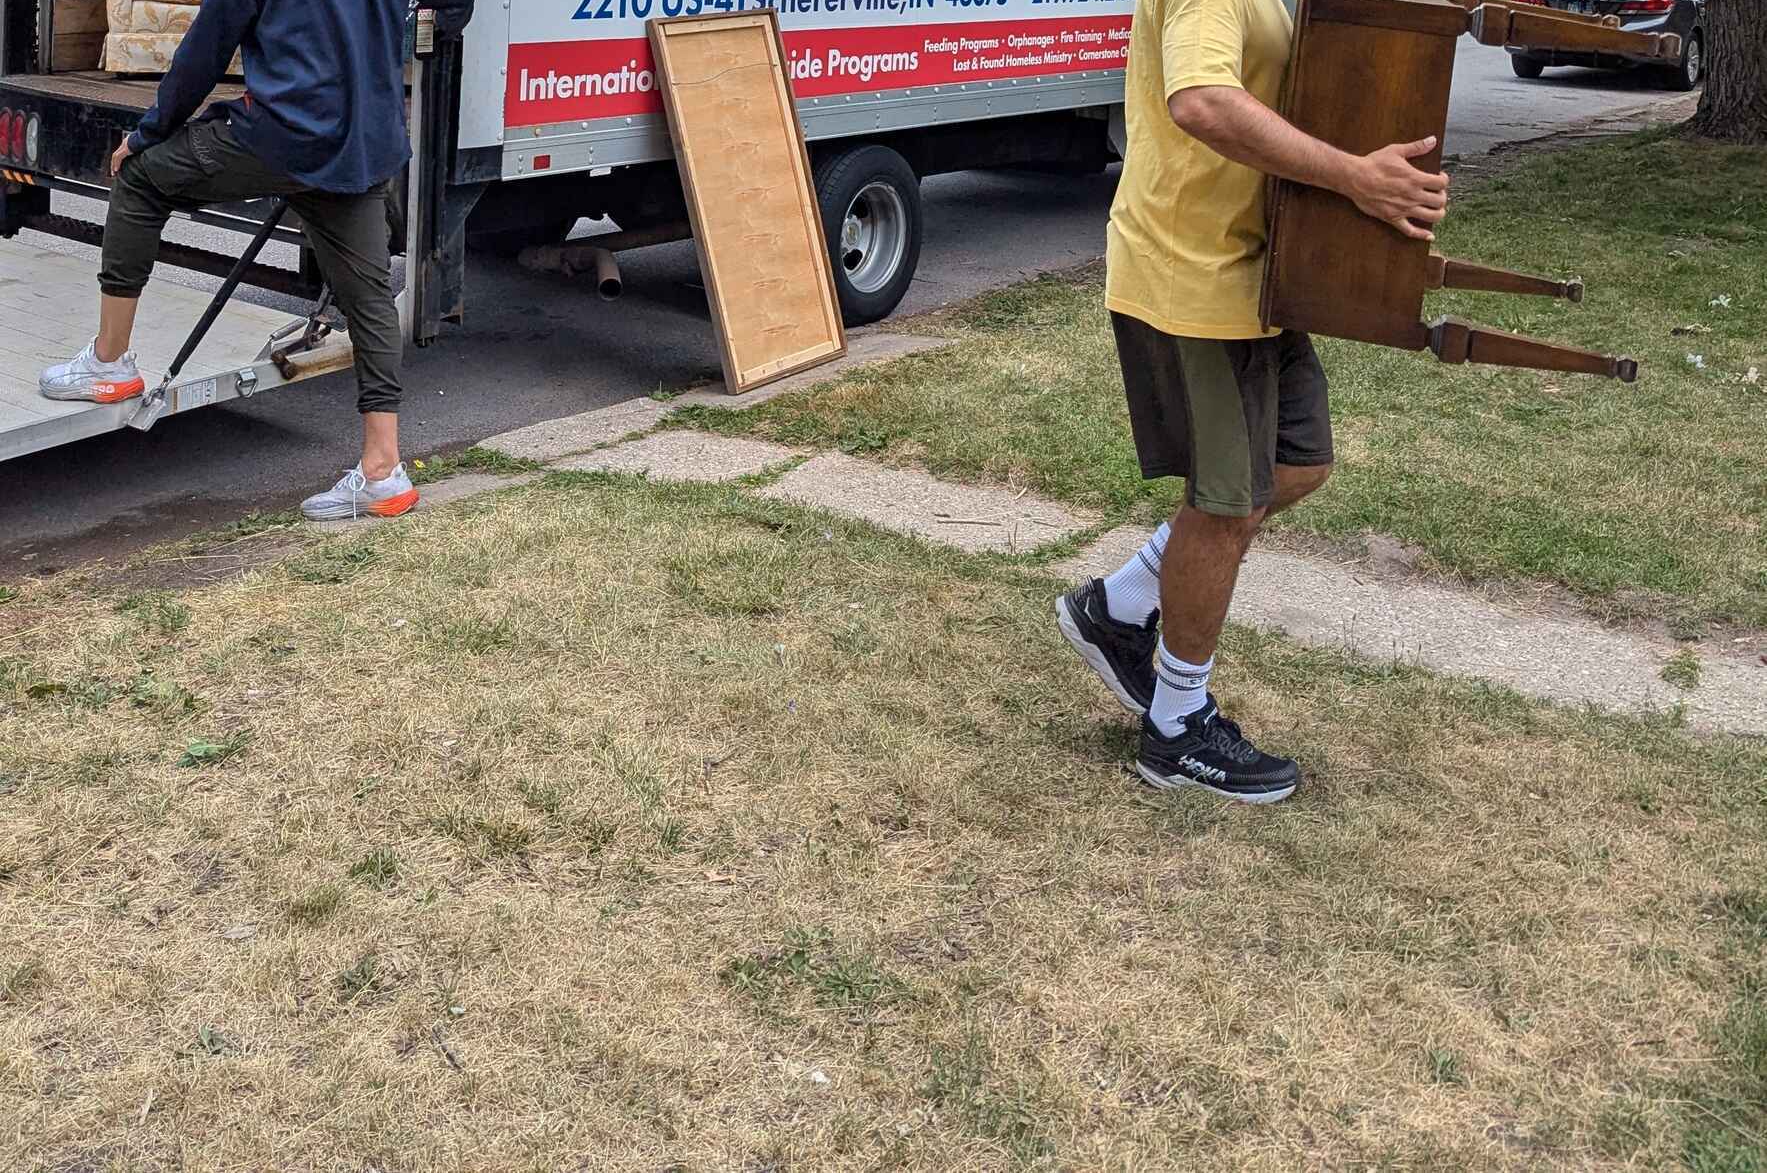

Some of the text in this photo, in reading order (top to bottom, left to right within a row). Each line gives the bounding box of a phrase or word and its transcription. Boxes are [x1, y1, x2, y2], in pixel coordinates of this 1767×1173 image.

[924, 38, 958, 54] Feeding
[960, 36, 999, 53] Programs
[1008, 33, 1054, 49] Orphanages
[1060, 31, 1073, 43] Fire
[1074, 29, 1103, 44] Training
[953, 57, 970, 71] Lost
[971, 57, 978, 69] &
[980, 54, 1005, 69] Found
[1006, 51, 1042, 67] Homeless
[1043, 48, 1073, 64] Ministry
[1079, 47, 1120, 61] Cornerstone
[519, 59, 659, 102] Internatio
[827, 48, 919, 82] Programs
